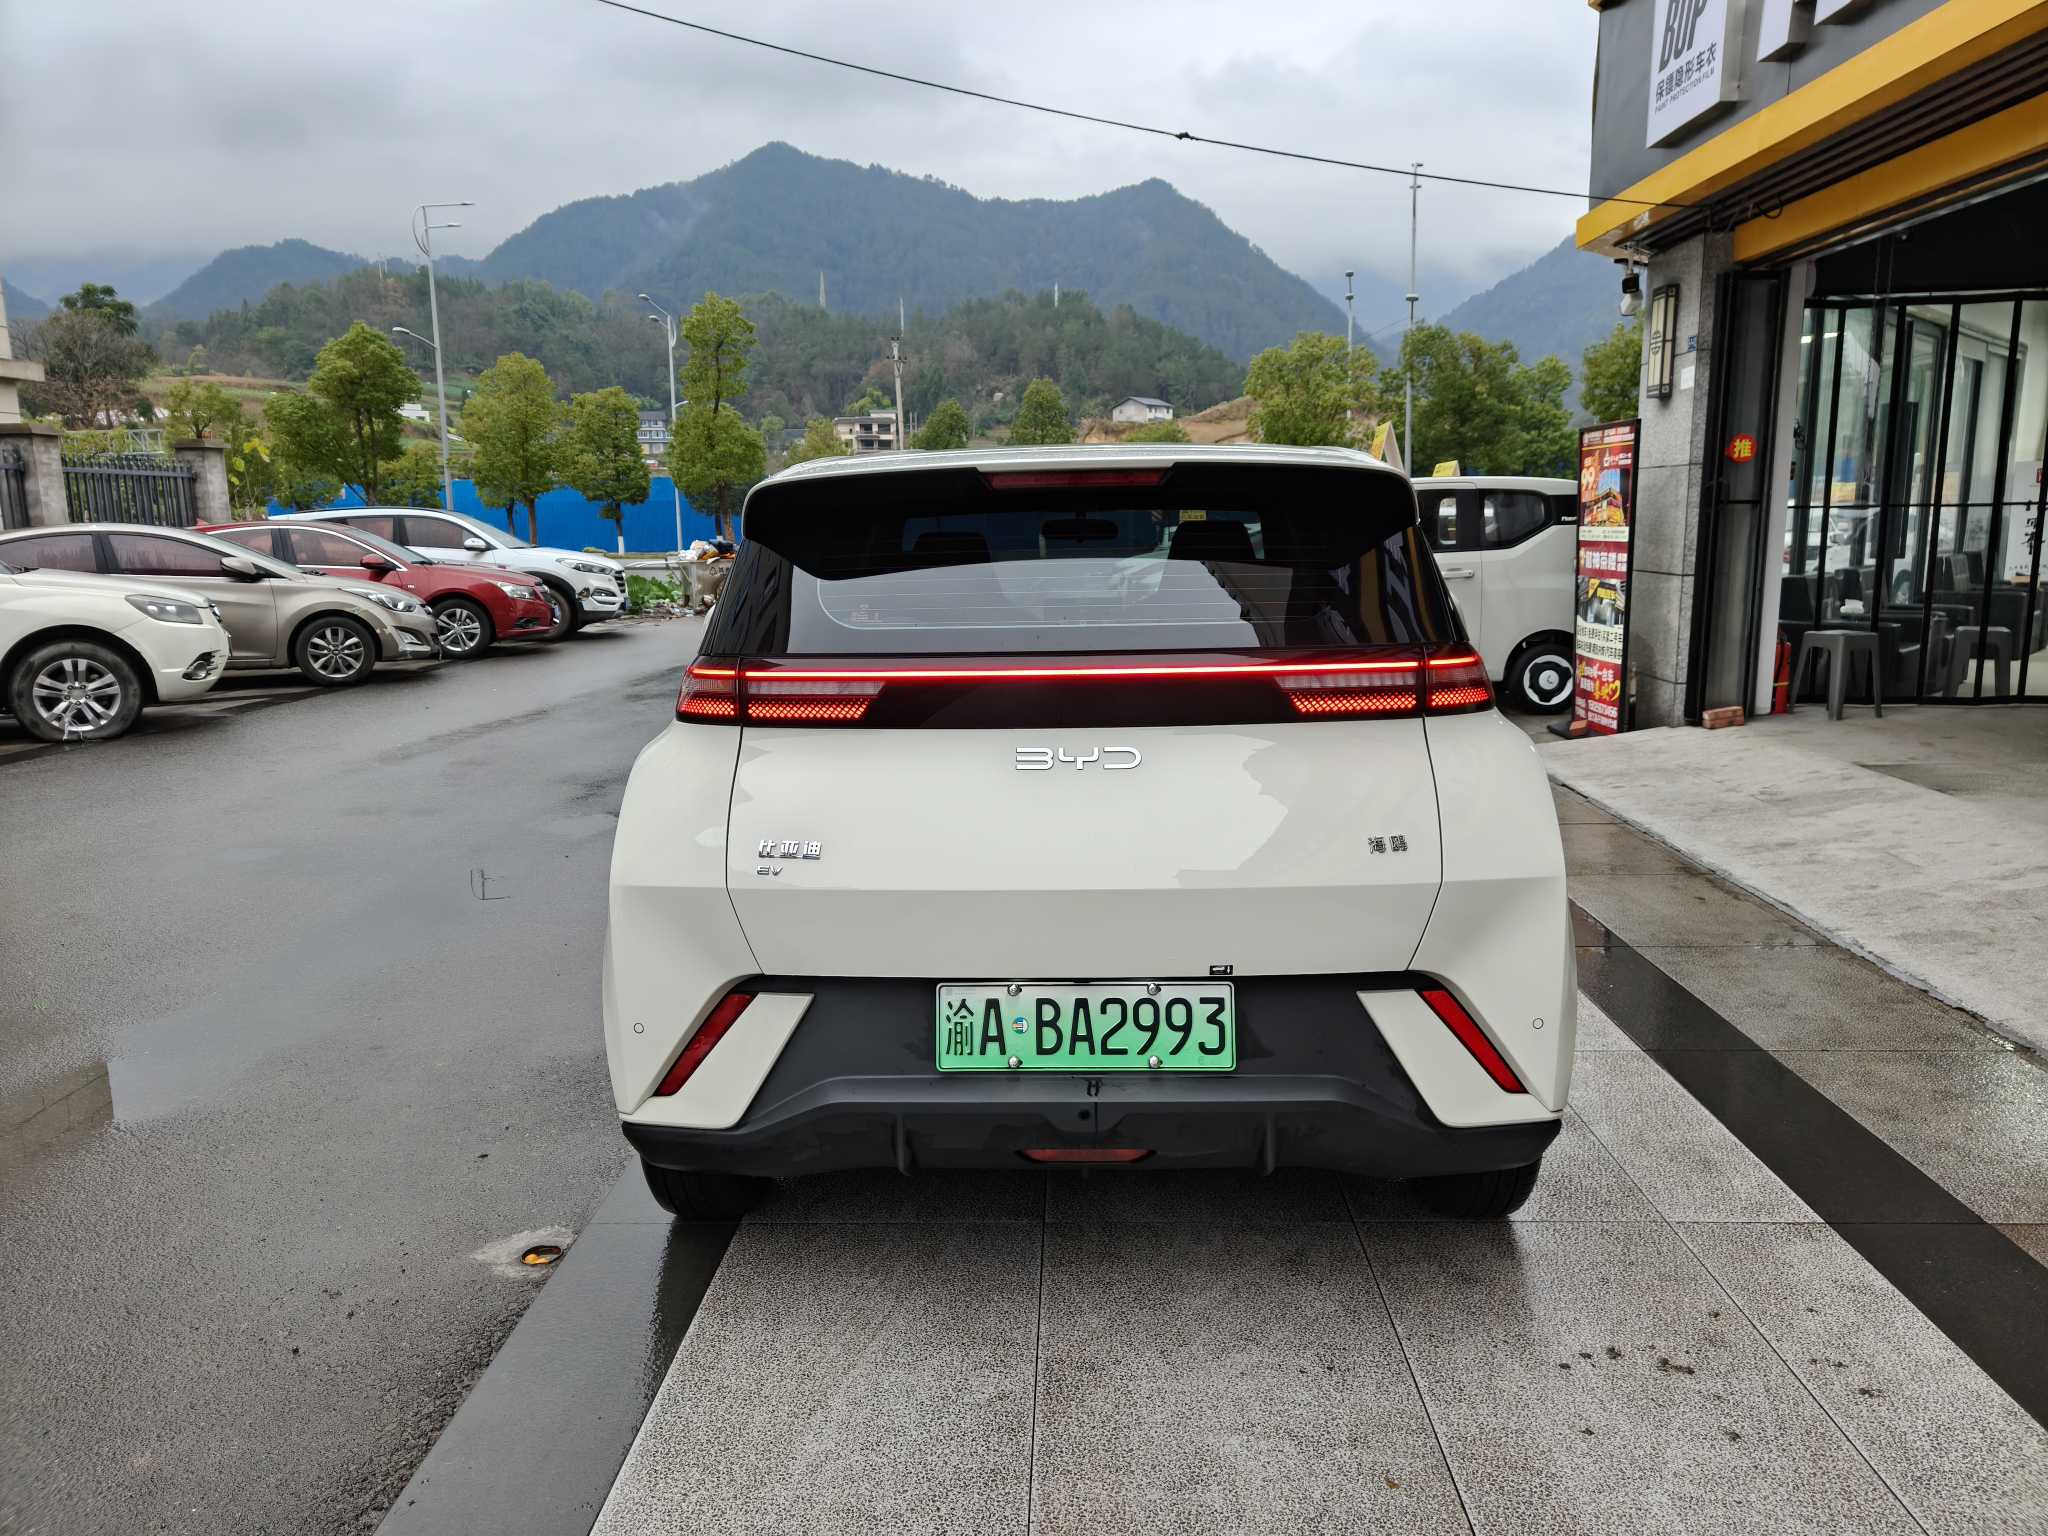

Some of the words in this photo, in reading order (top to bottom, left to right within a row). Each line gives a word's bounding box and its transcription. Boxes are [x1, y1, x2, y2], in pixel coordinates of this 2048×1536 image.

[1016, 746, 1142, 770] BYD
[758, 839, 822, 859] 比亚迪
[757, 865, 783, 876] EV
